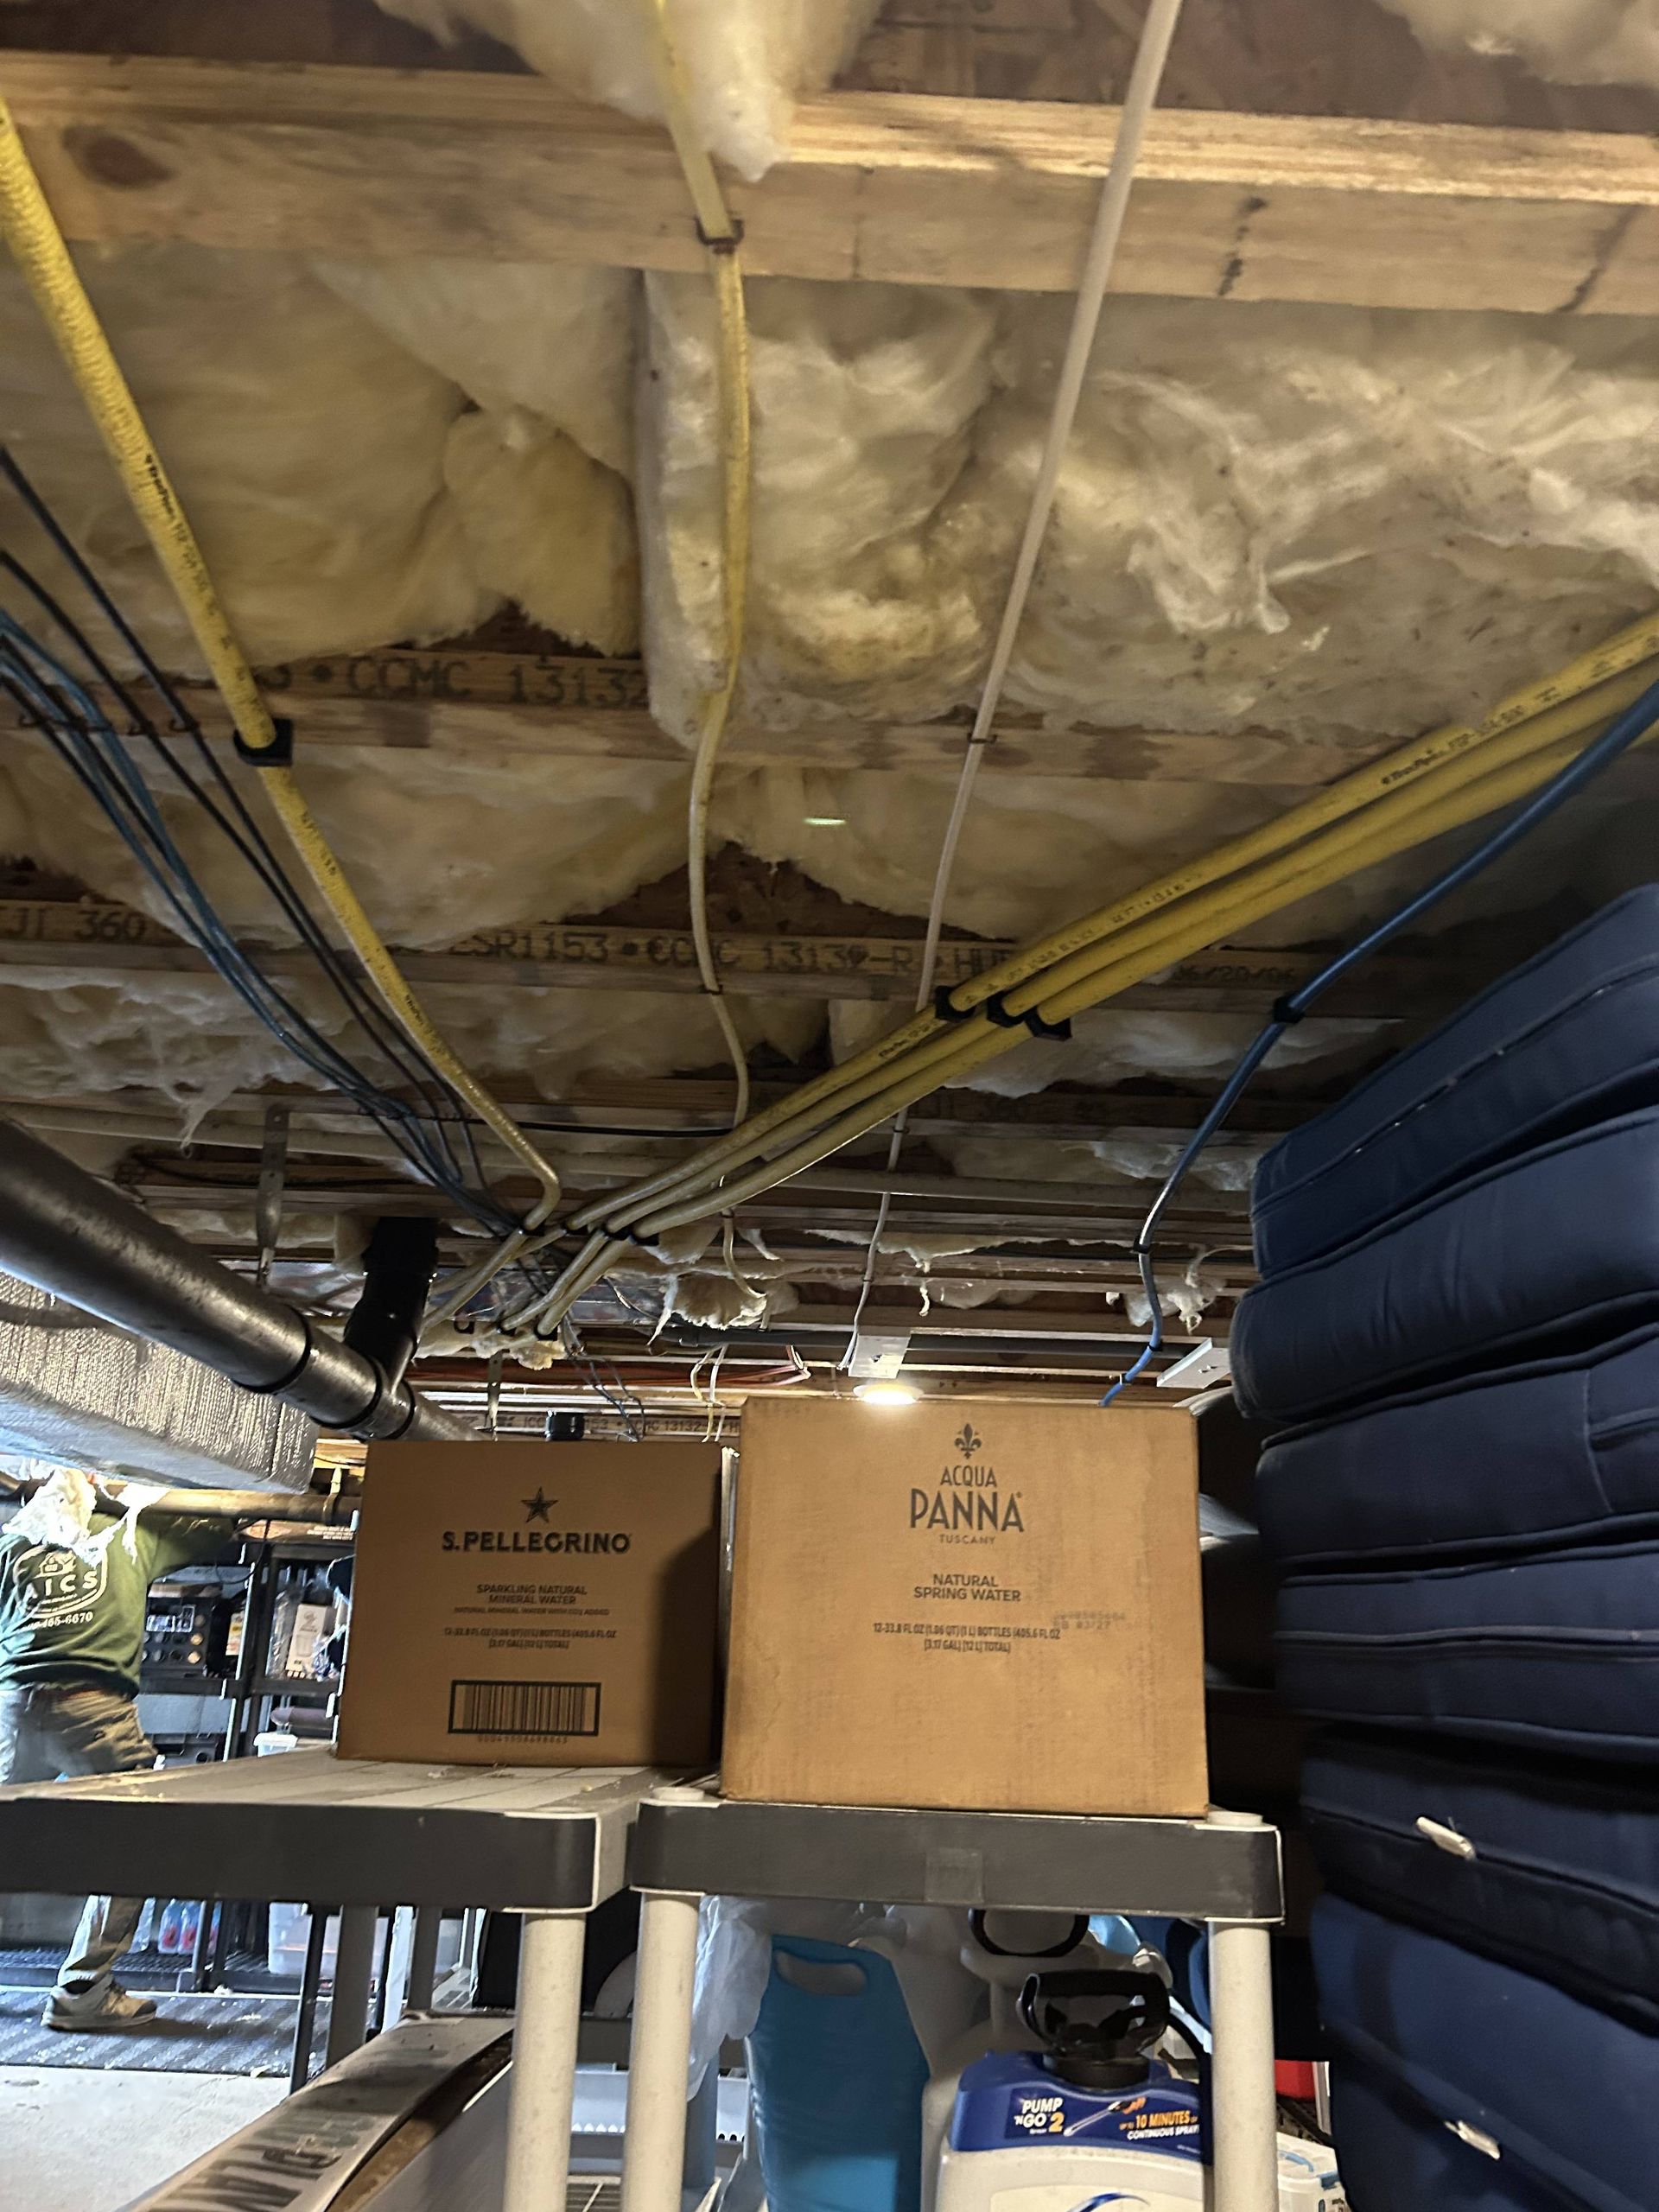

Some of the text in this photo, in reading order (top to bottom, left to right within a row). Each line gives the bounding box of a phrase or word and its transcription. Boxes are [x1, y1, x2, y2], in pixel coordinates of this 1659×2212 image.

[349, 655, 469, 697] CCMC
[940, 1465, 997, 1487] ACQUA
[939, 1534, 996, 1545] TUSCANY
[933, 1573, 999, 1587] NATURAL
[476, 1584, 588, 1595] SPARKLING NATURAL
[913, 1586, 1020, 1602] SPRING WATER
[489, 1595, 576, 1605] MINERAL WATER
[977, 1625, 1012, 1638] BOTTLES
[1022, 2097, 1064, 2114] PUMP
[1023, 2113, 1047, 2128] GO
[1048, 2112, 1065, 2133] 2
[1135, 2113, 1147, 2129] 10
[1148, 2110, 1191, 2127] MINUTES
[1127, 2126, 1174, 2140] CONTINUOUS
